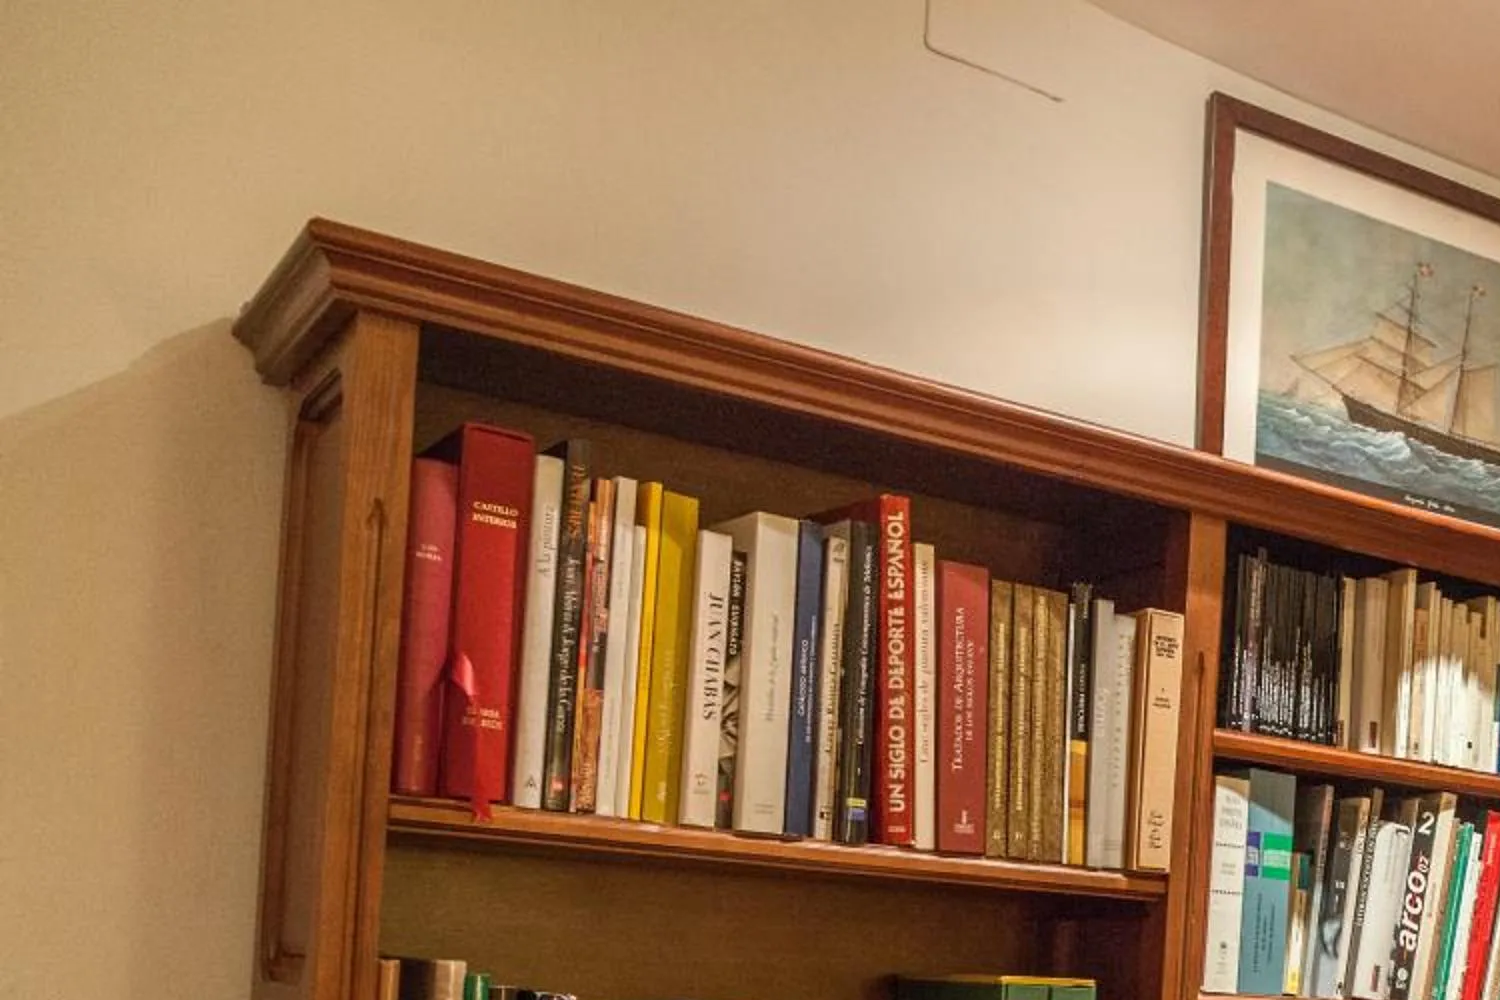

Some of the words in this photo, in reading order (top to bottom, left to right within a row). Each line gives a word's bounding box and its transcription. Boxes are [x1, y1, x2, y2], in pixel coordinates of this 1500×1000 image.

[883, 510, 905, 601] ESPAÑOL
[706, 591, 723, 642] JUAN
[888, 606, 905, 690] DEPORTE
[702, 646, 722, 721] CHABÁS
[888, 695, 905, 720] DE
[888, 726, 906, 779] SIGLO
[889, 782, 906, 813] UN
[1418, 812, 1435, 836] 2
